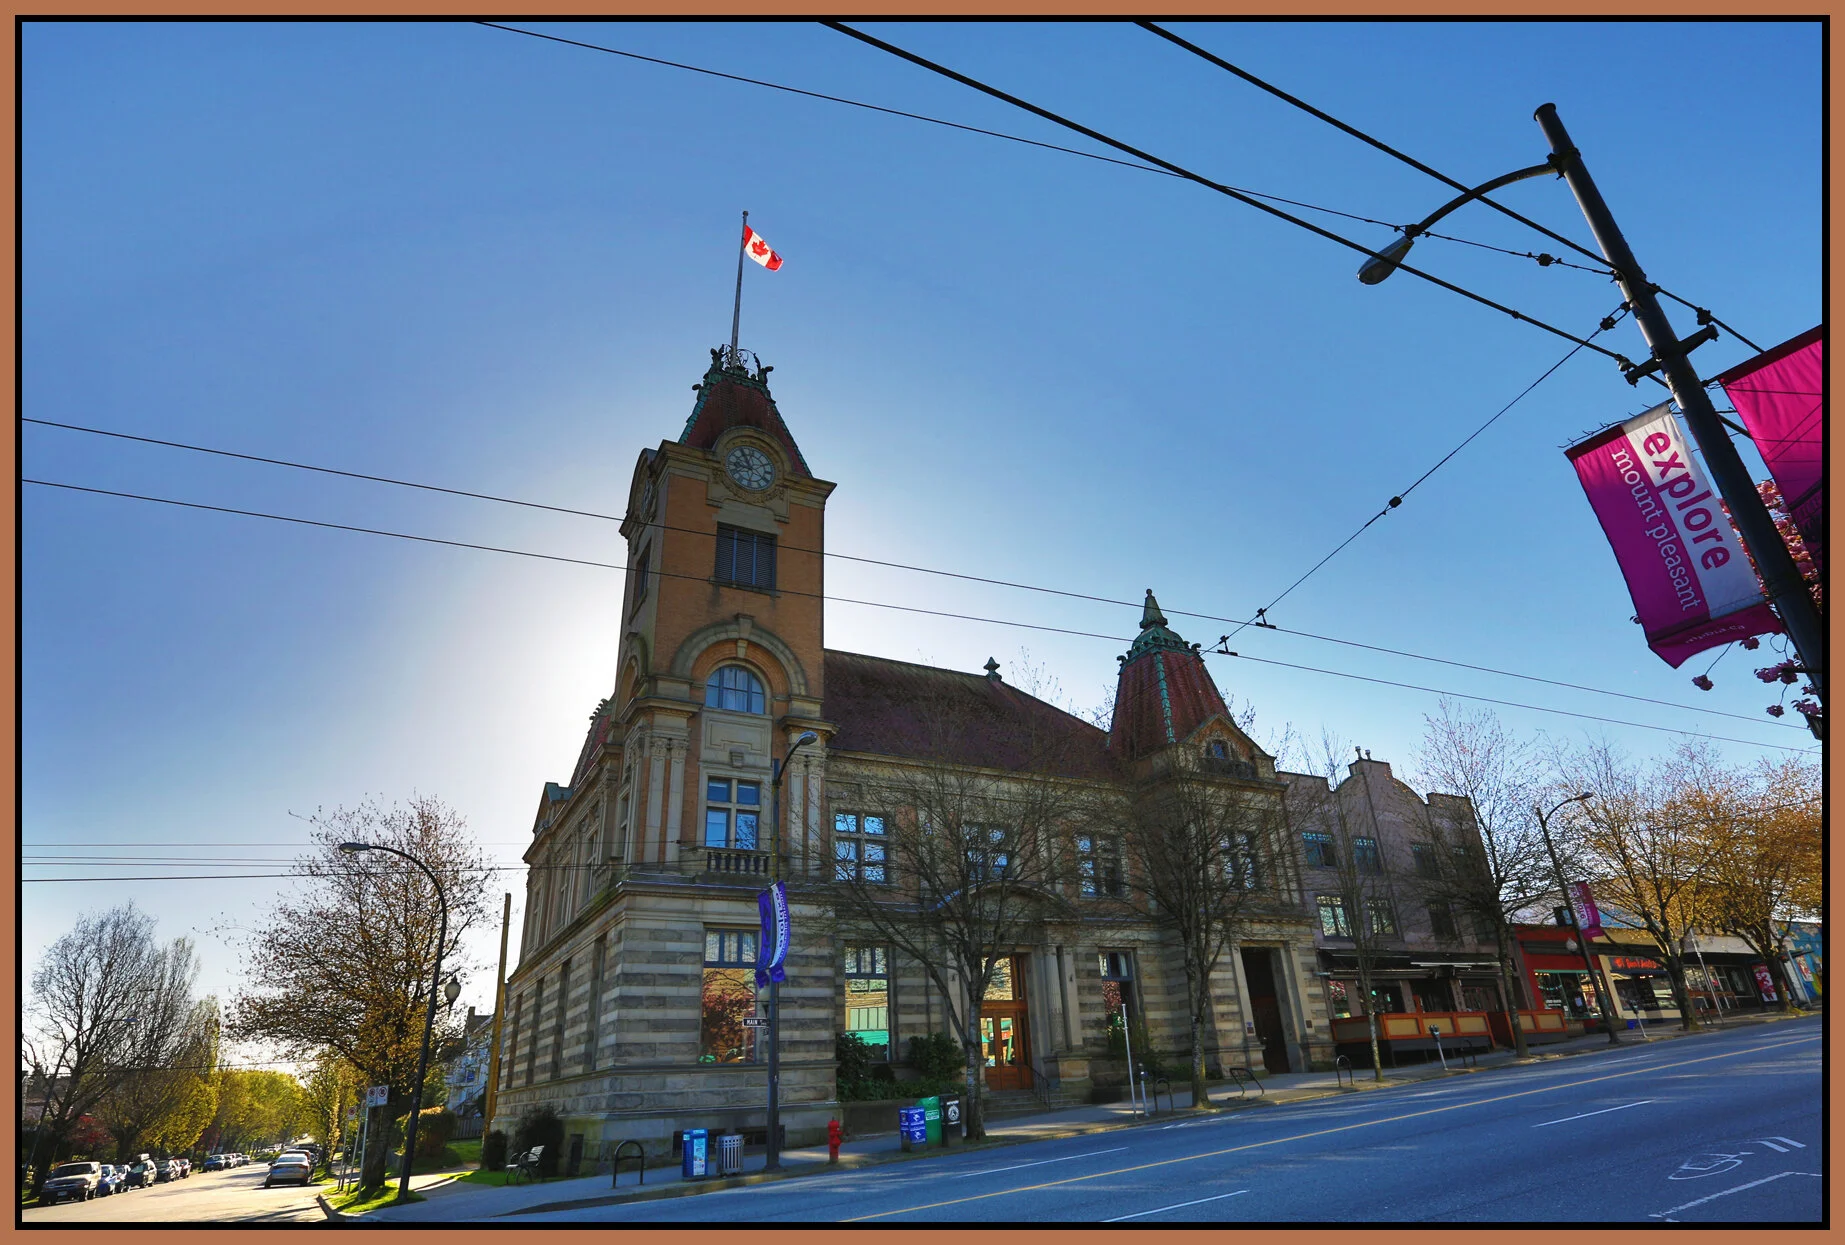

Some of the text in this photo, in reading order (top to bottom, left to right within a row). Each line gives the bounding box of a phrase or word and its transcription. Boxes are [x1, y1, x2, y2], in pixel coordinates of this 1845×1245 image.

[1611, 447, 1702, 612] mount pleasant
[1643, 431, 1731, 570] explore
